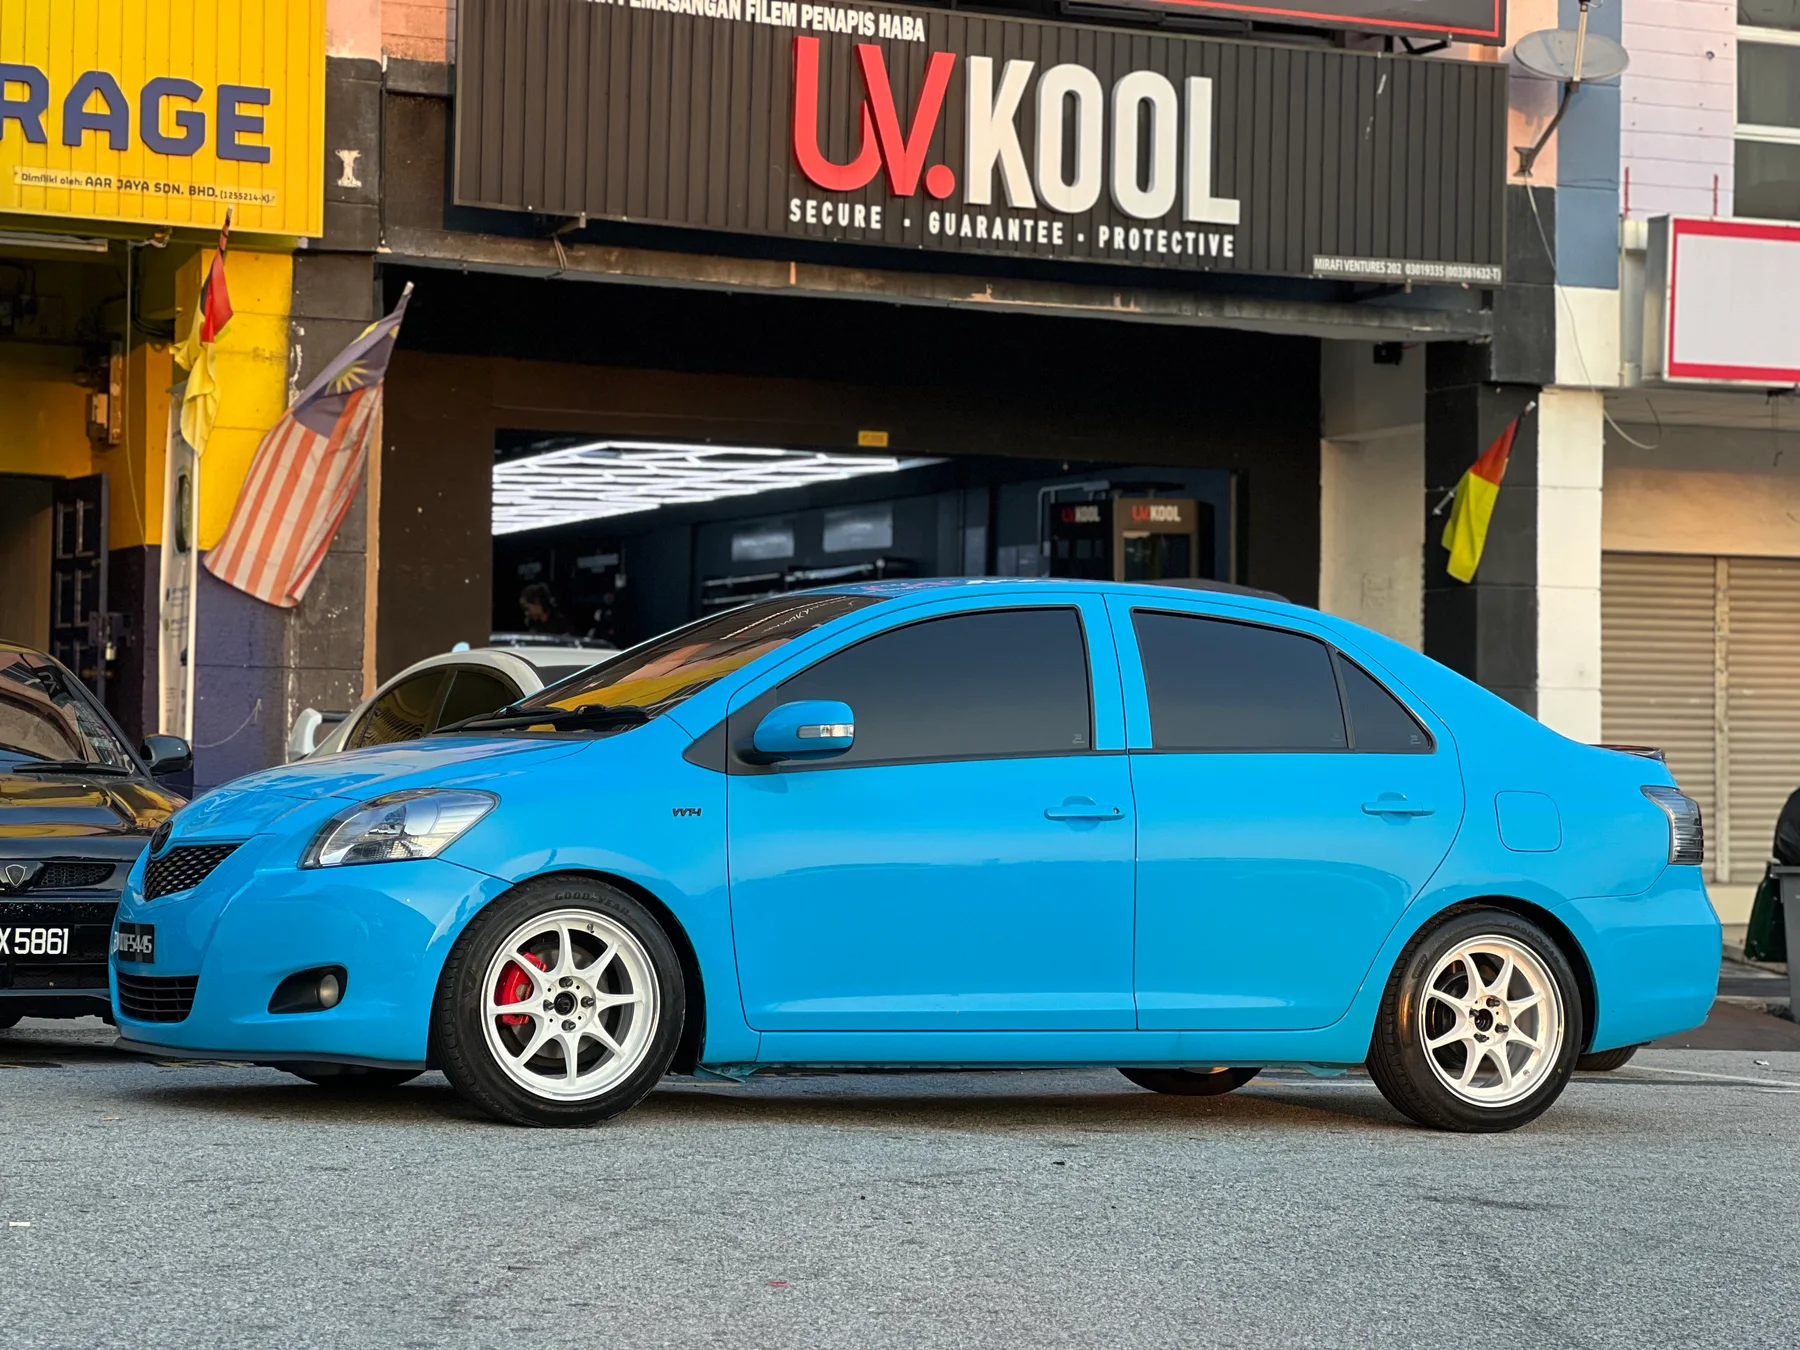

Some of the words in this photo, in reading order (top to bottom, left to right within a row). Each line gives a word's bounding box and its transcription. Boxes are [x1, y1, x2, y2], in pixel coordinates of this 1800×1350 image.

[617, 0, 741, 20] ASANGAN
[745, 0, 798, 27] FILEM
[801, 4, 876, 36] PENAPIS
[878, 13, 926, 42] HABA
[0, 63, 271, 164] RAGE
[85, 176, 112, 189] AAR
[116, 179, 150, 192] JAYA
[154, 182, 184, 195] SDN.
[189, 185, 218, 198] BHD.
[789, 198, 882, 229] SECURE
[928, 211, 1064, 245] GUARANTEE
[1098, 225, 1234, 258] PROTECTIVE
[1313, 257, 1344, 272] MIRAFI
[1344, 259, 1386, 274] VENTURES
